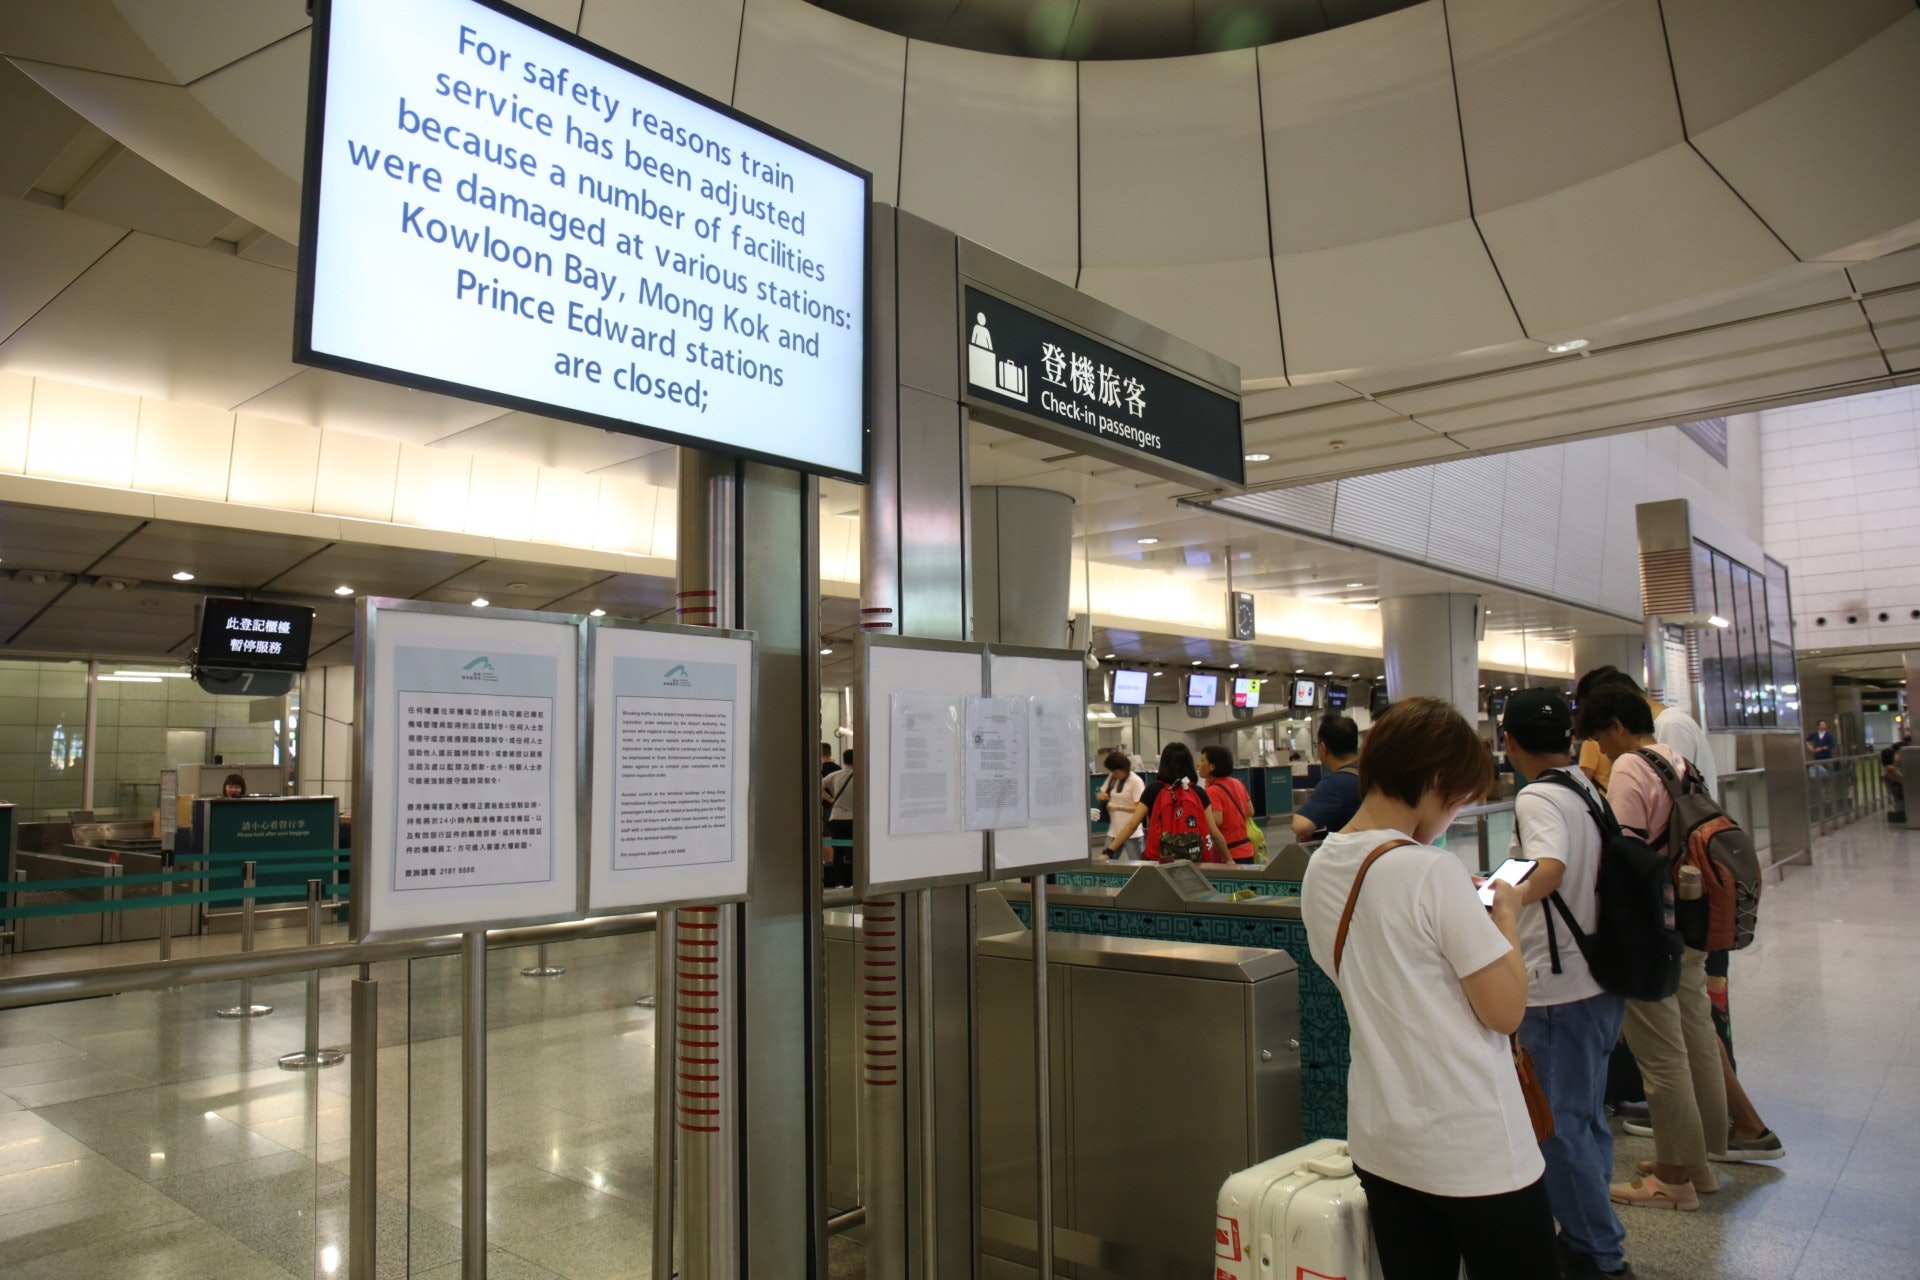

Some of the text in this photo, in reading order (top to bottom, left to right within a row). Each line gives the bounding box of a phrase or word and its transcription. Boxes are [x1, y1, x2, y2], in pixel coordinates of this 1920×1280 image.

[459, 24, 794, 194] For safety reasons train
[398, 96, 825, 282] because a number of facilities
[435, 73, 805, 236] service has been adjusted
[347, 139, 852, 330] were damaged at various stations:
[401, 201, 819, 359] Kowloon Bay, Mong Kok and
[456, 268, 784, 387] Prince Edward stations
[555, 353, 708, 414] are closed;
[1041, 342, 1147, 418] 登機旅客
[1041, 390, 1161, 449] Check-in passengers
[229, 638, 282, 655] 暫停服務
[241, 672, 254, 692] 7
[1121, 705, 1130, 716] 14
[440, 866, 456, 875] 2181
